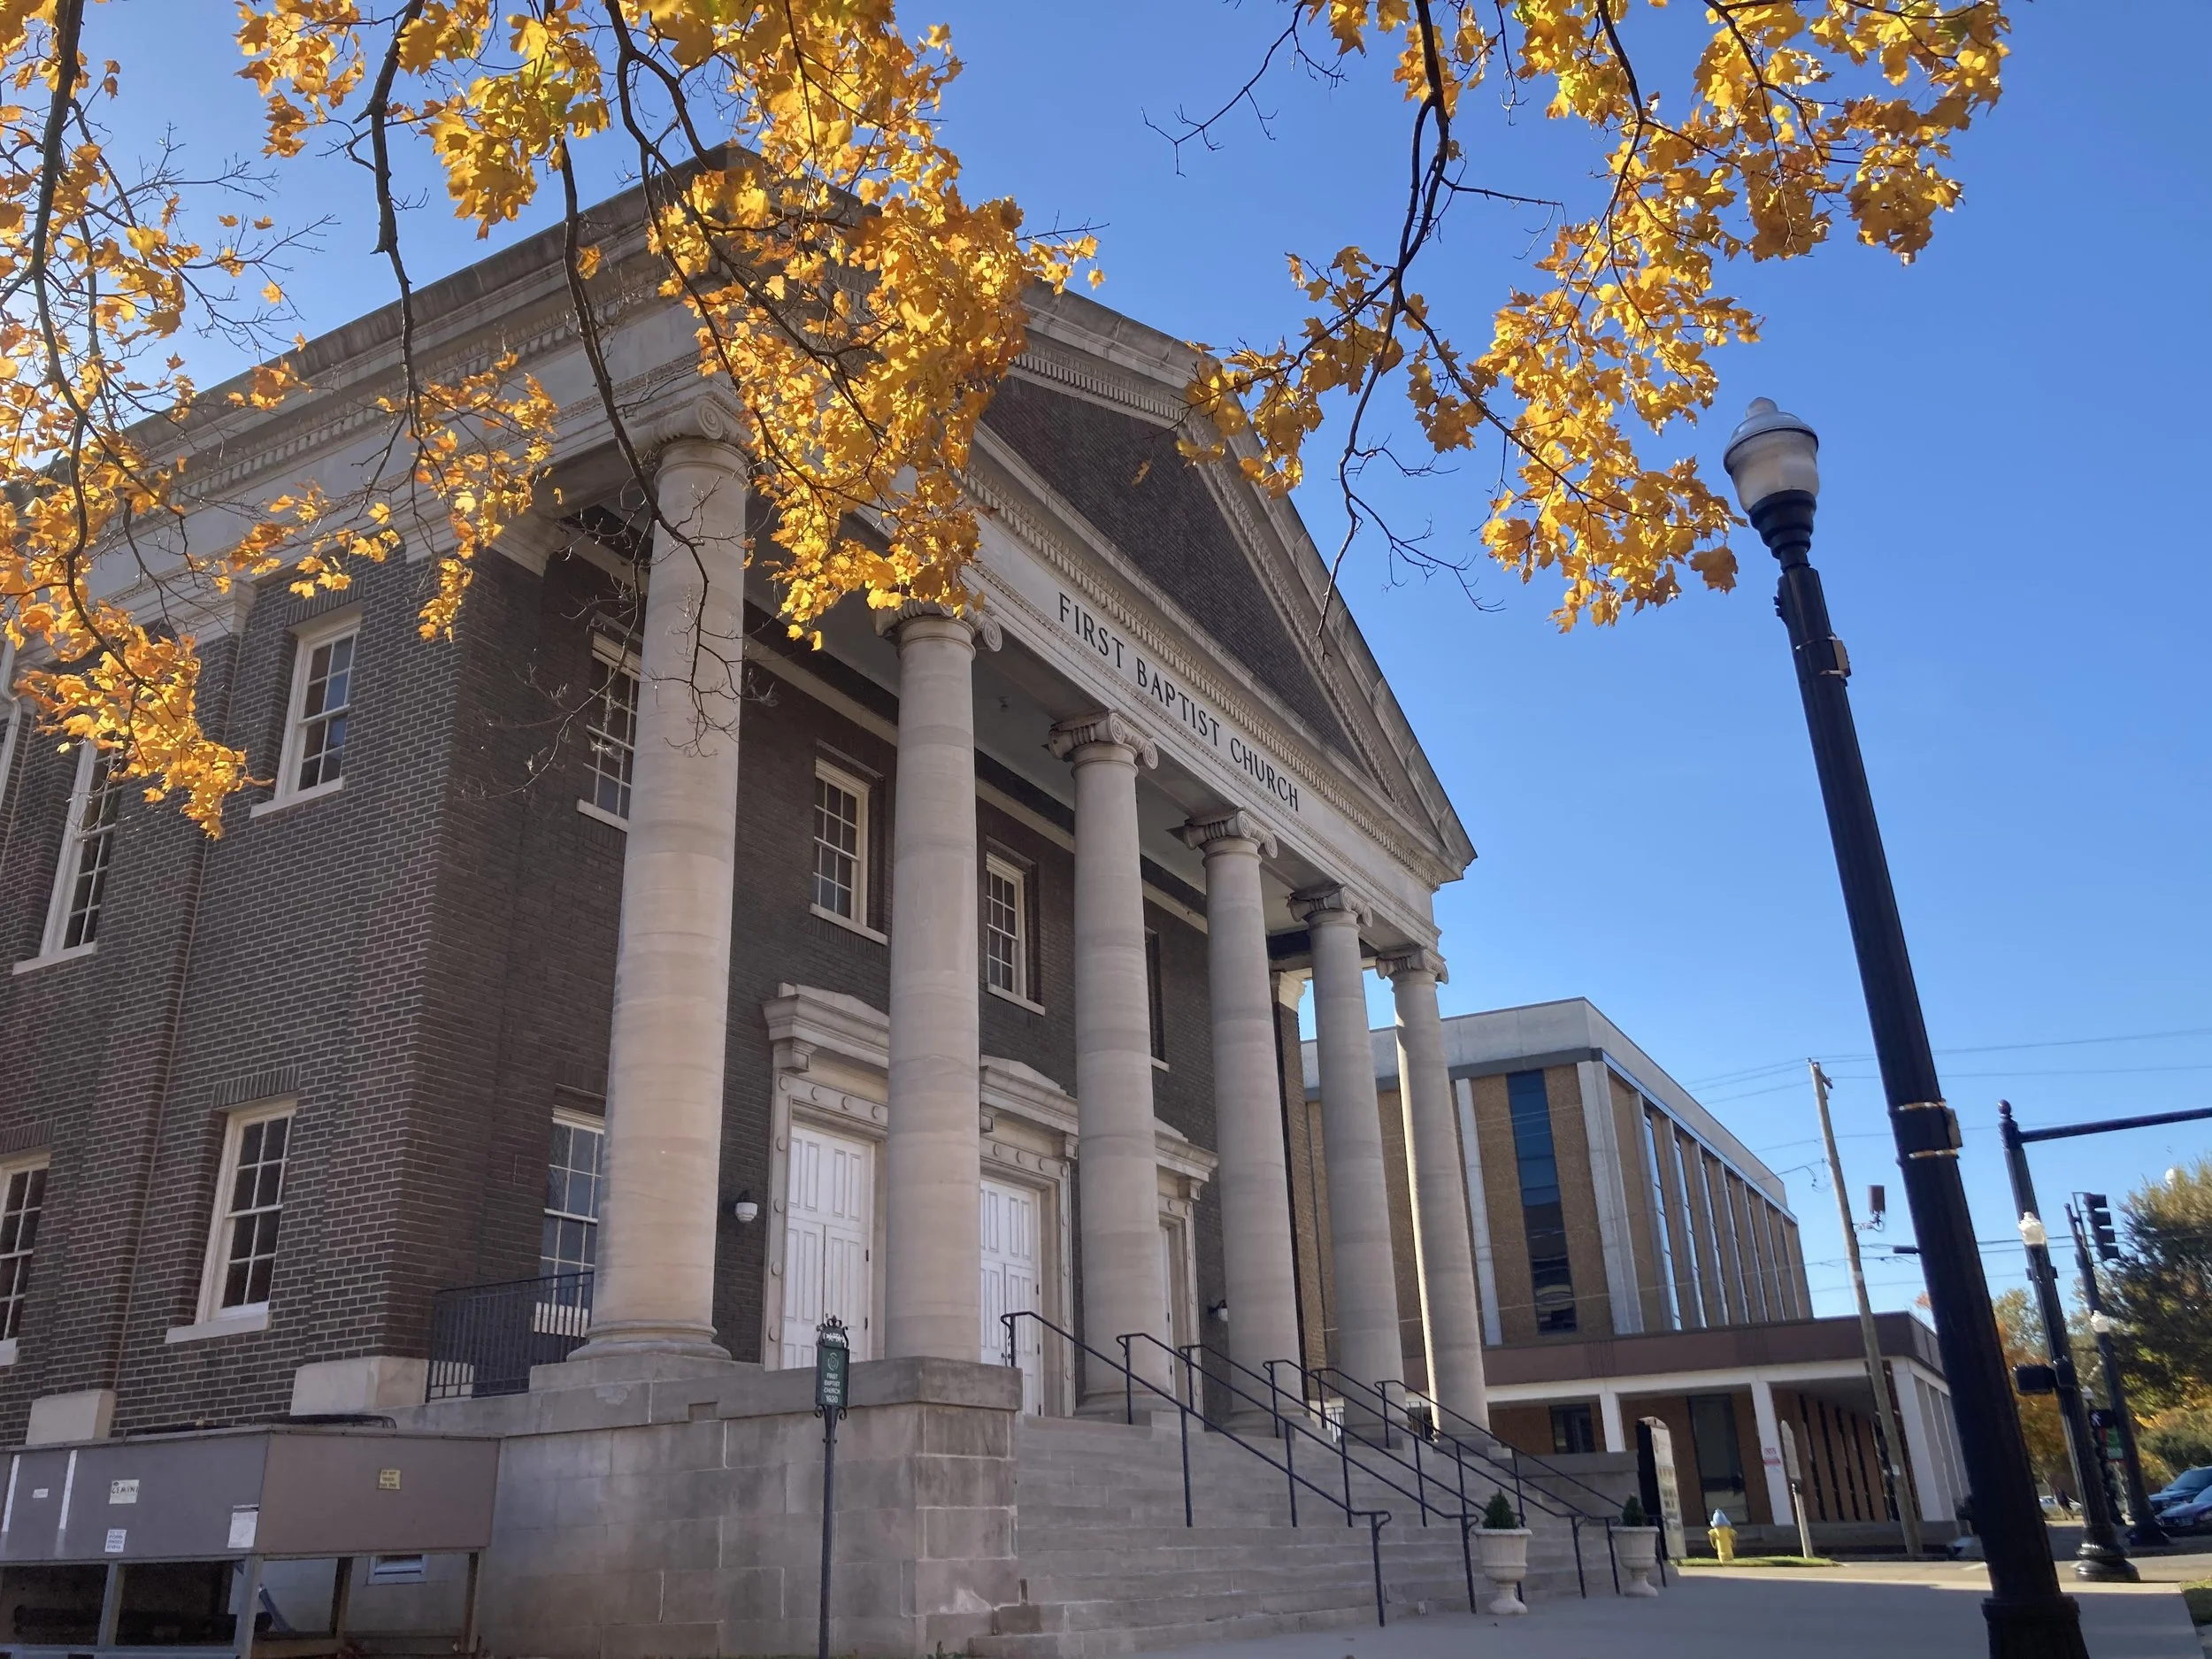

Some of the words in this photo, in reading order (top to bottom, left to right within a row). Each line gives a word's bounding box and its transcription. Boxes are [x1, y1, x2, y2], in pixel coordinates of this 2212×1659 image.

[1058, 591, 1124, 669] FIRST
[1136, 657, 1220, 747] BAPTIST
[1230, 737, 1299, 812] CHURCH
